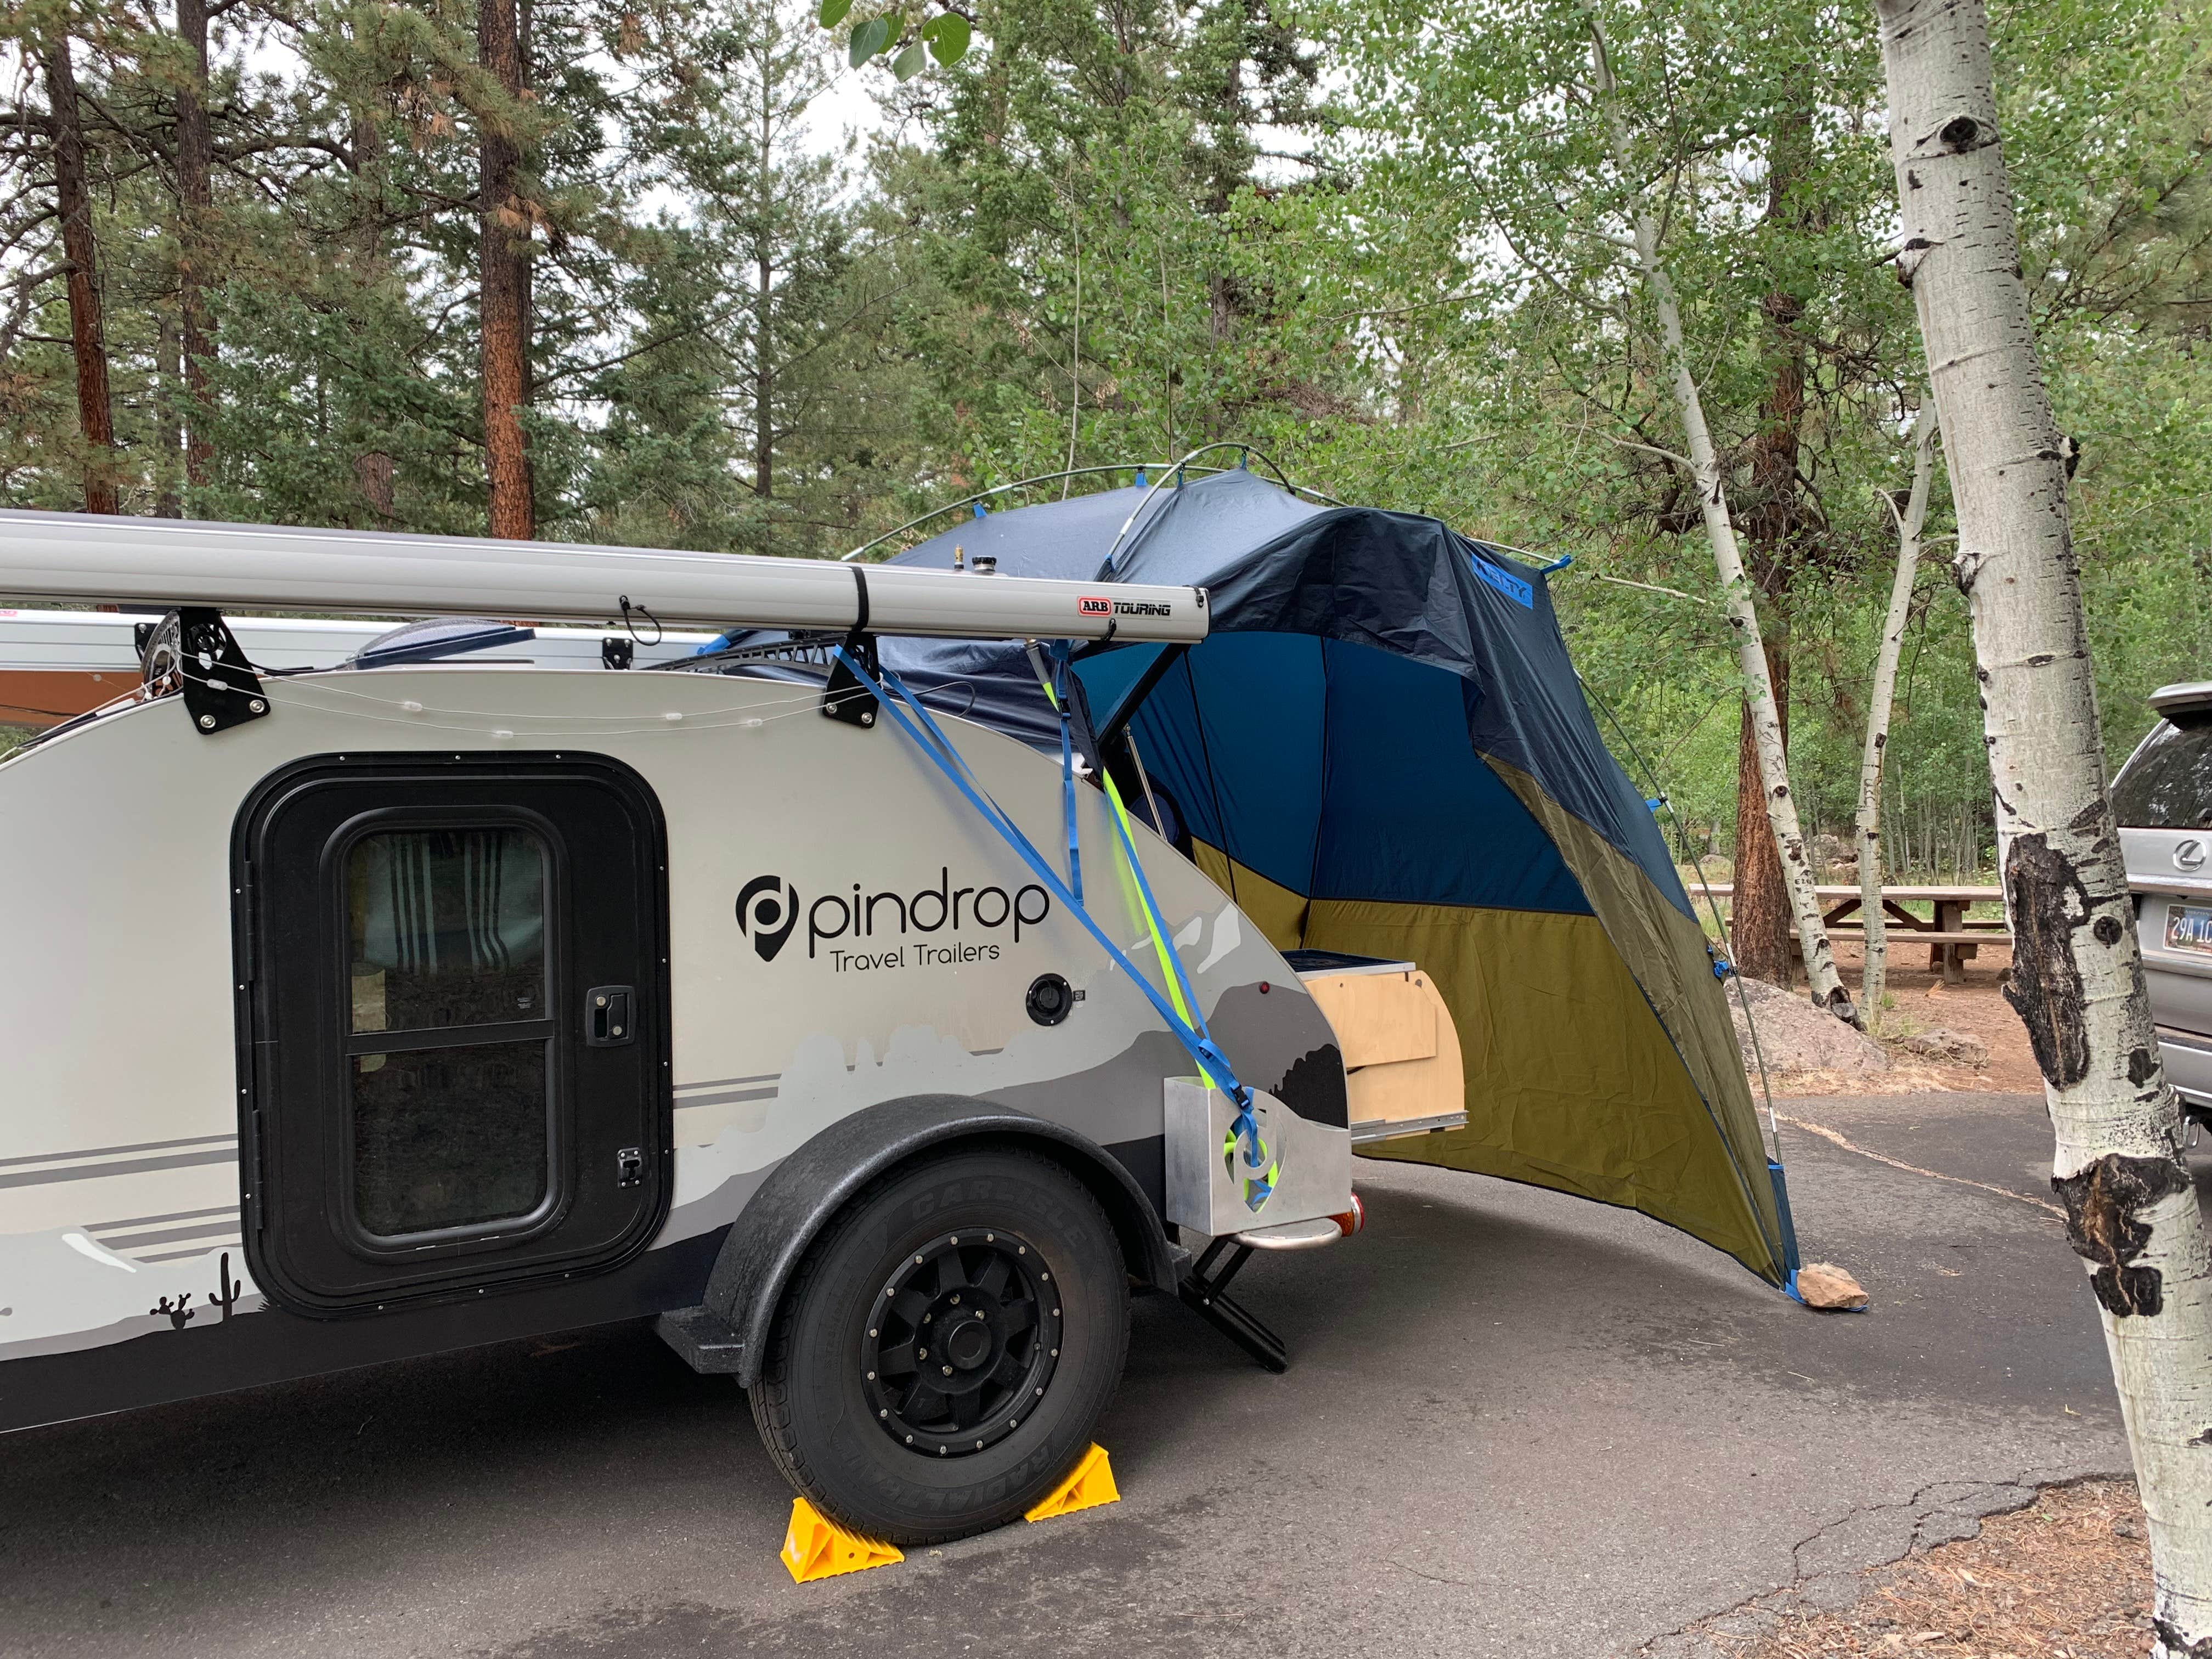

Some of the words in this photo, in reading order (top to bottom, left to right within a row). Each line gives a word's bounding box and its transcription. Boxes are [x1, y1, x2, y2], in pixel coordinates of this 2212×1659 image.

[1083, 601, 1108, 612] ARB
[1113, 602, 1171, 616] TOURING
[809, 866, 1049, 959] pindrop
[2171, 916, 2194, 941] 29A
[830, 946, 905, 972] Travel
[913, 941, 1000, 966] Trailers
[911, 1179, 1088, 1248] CARLISLE
